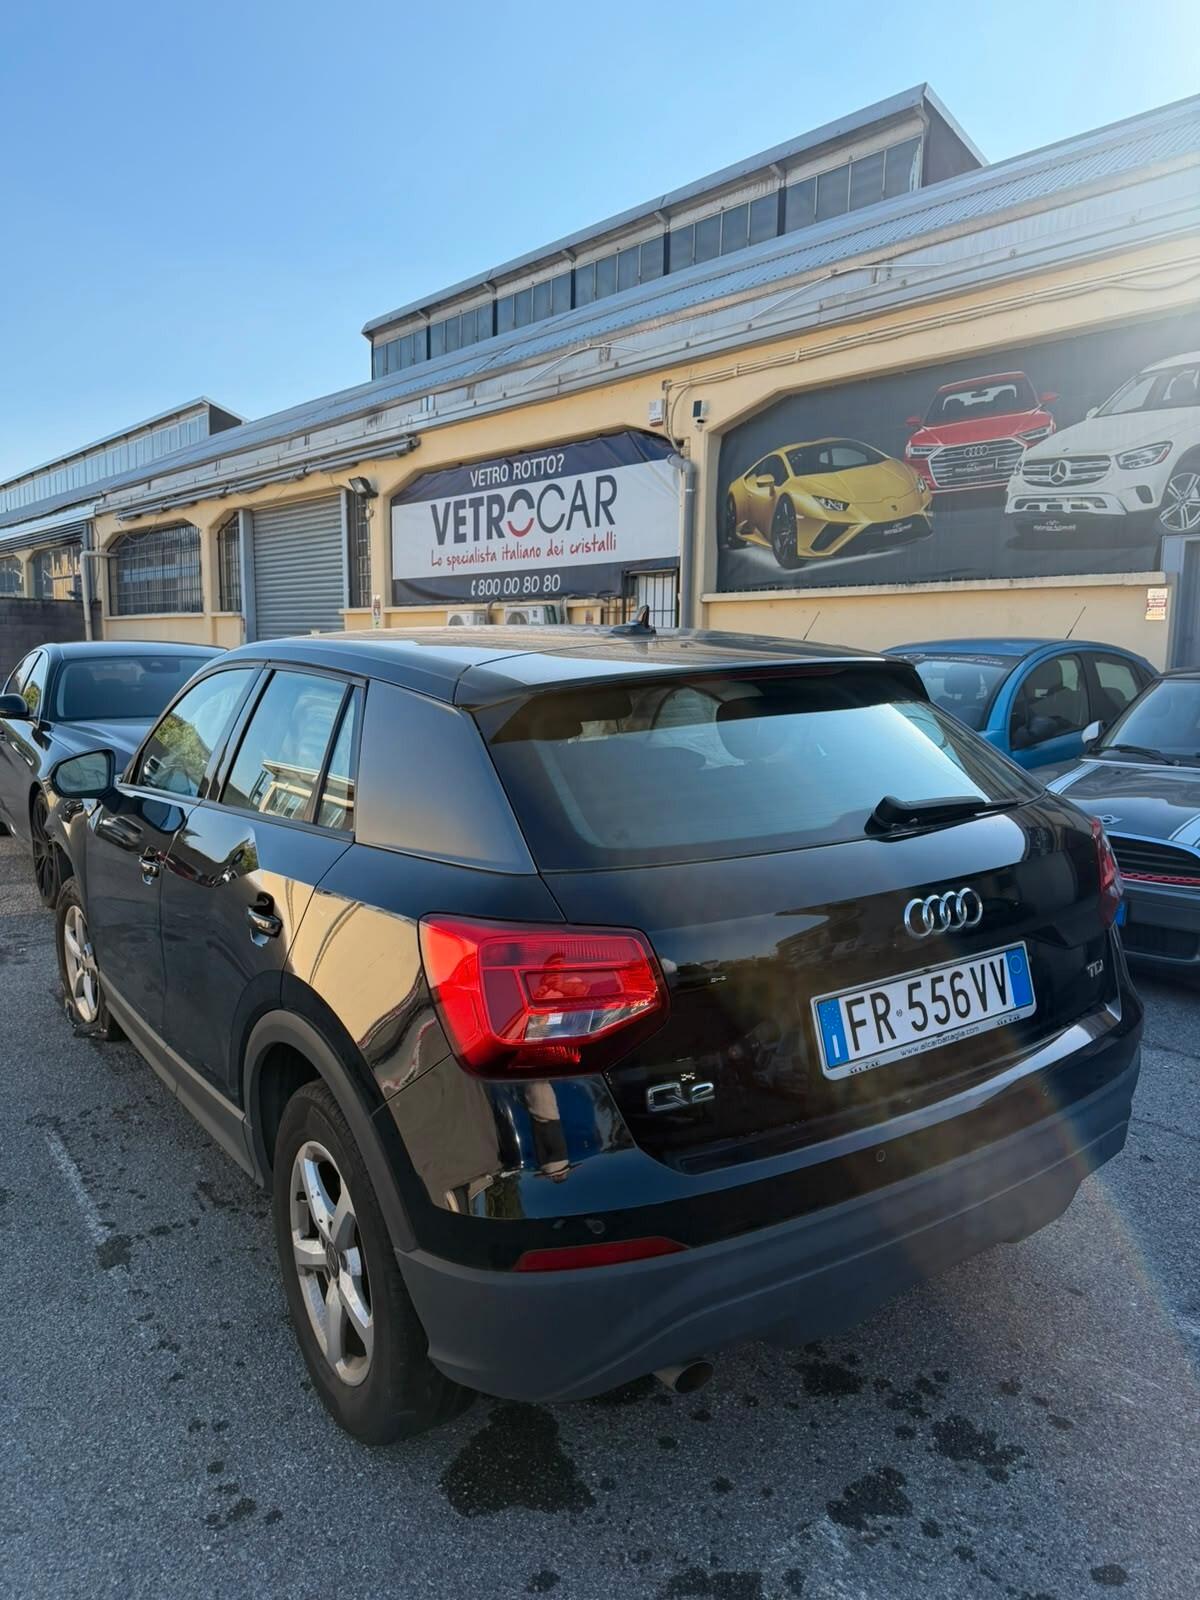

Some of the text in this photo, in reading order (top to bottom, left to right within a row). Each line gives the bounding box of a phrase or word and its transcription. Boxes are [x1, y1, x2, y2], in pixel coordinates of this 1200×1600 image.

[470, 453, 565, 488] VETRO ROTTO?
[430, 474, 618, 546] VETROCAR
[431, 531, 617, 571] Lo specialista italiano dei cristalli
[478, 574, 561, 596] 800 00 80 80
[845, 991, 897, 1051] FR
[907, 958, 1008, 1032] 556VV
[647, 1082, 715, 1112] Q2
